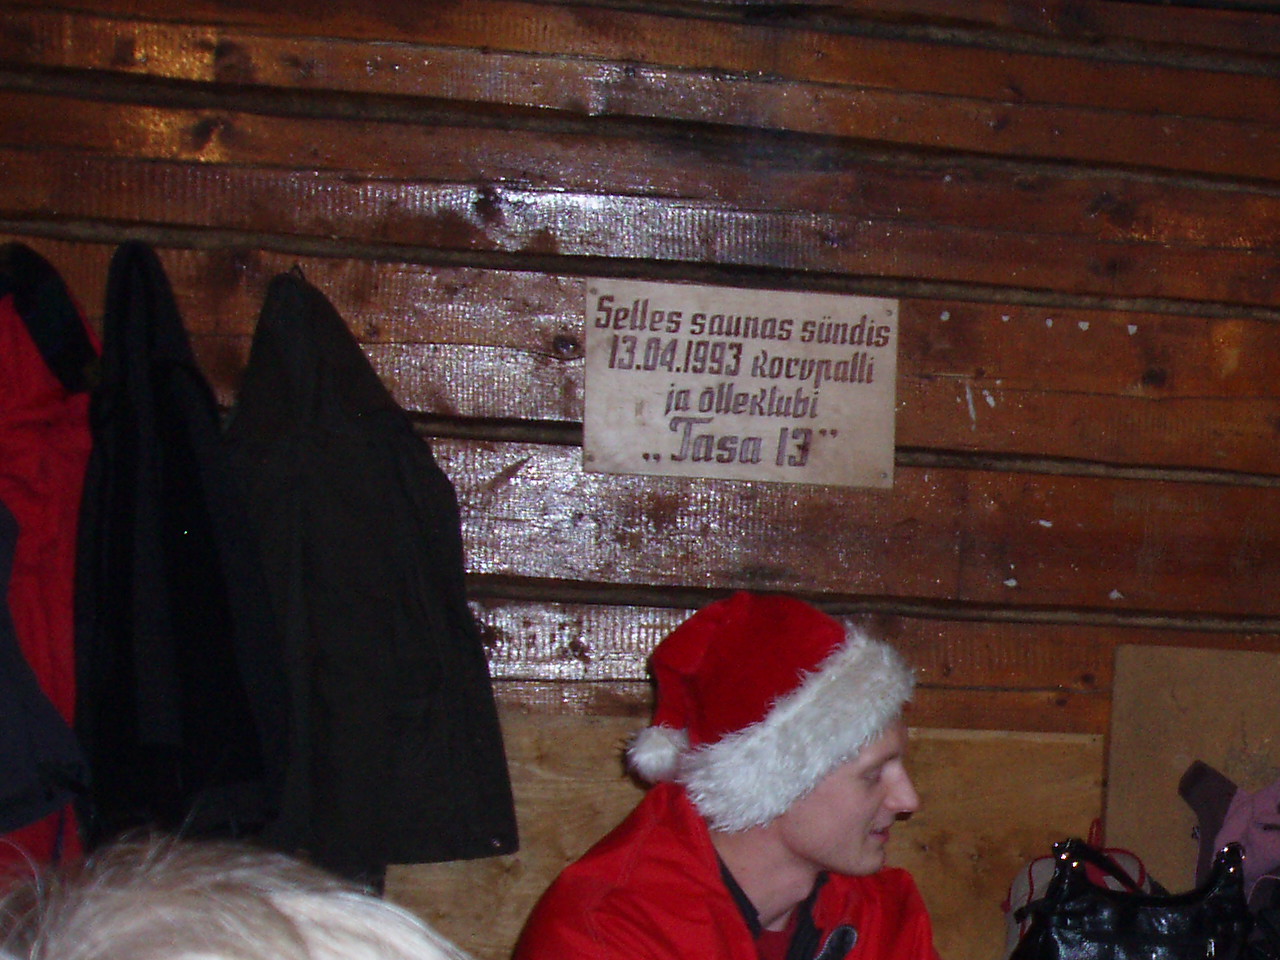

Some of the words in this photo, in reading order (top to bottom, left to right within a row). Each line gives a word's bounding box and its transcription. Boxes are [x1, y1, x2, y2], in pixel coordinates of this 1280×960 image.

[594, 294, 683, 334] Selles
[689, 312, 794, 342] saunas
[800, 314, 892, 348] sündis
[607, 334, 743, 377] 13.04.1993
[664, 383, 691, 416] ja
